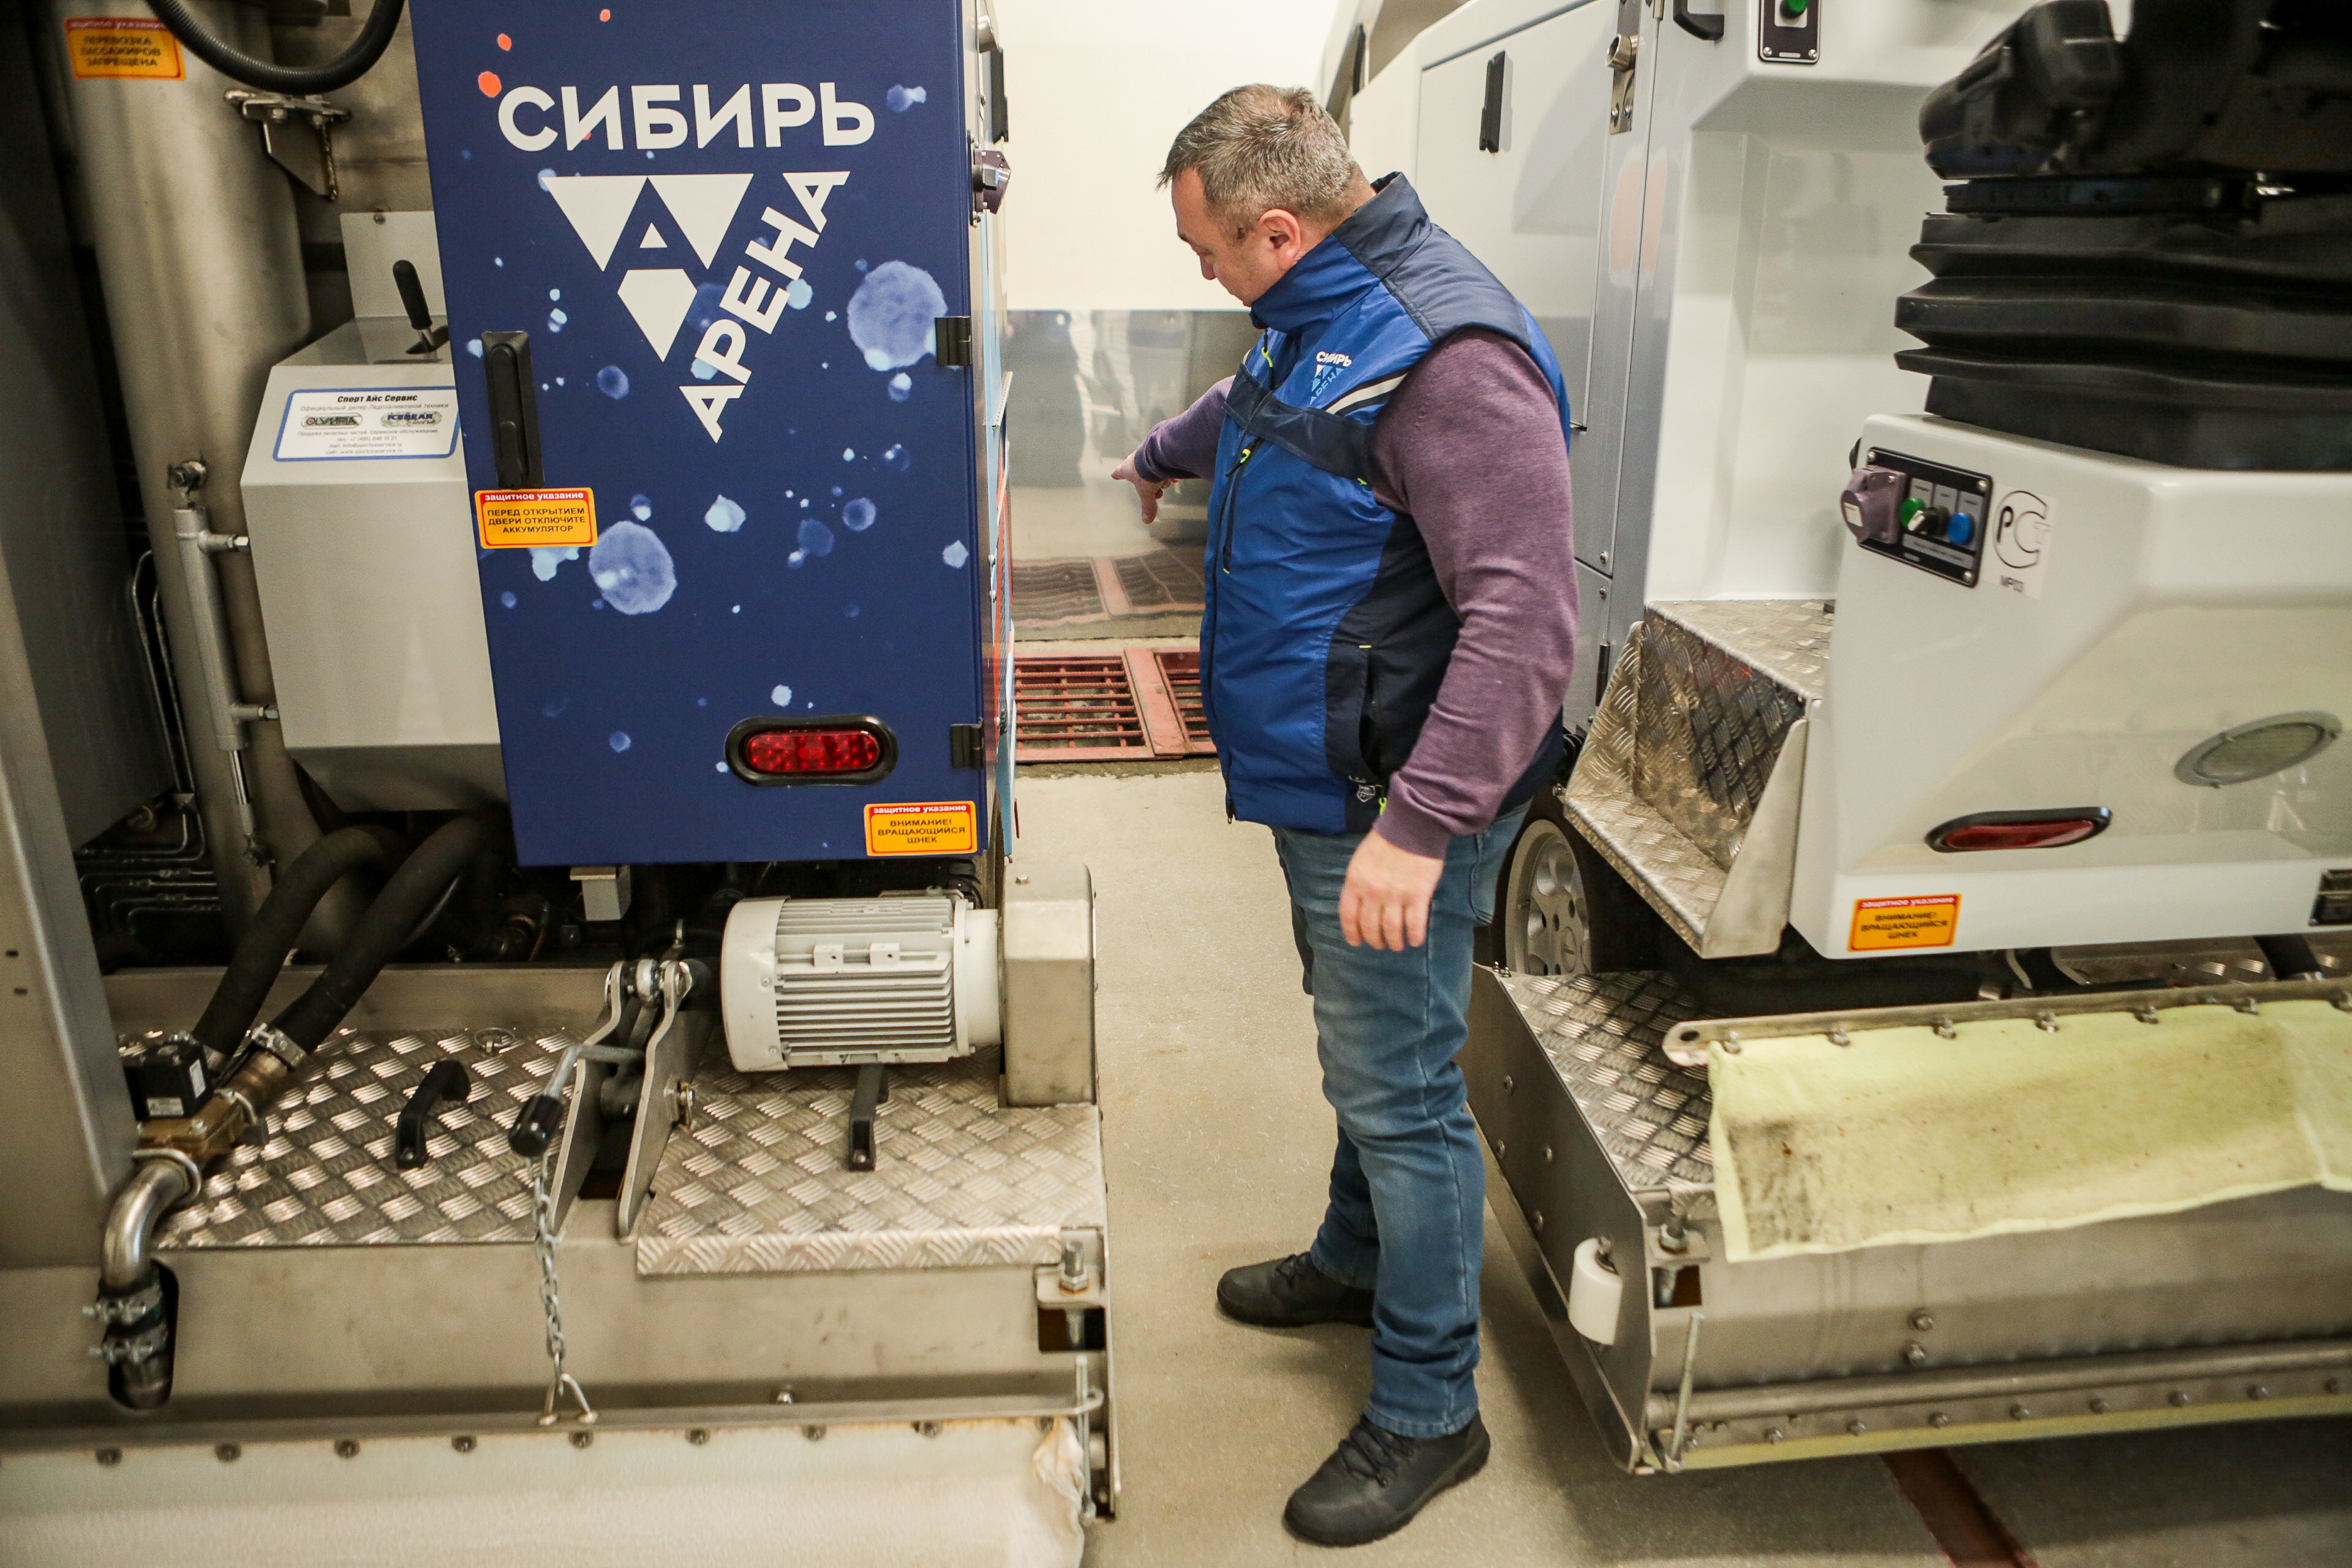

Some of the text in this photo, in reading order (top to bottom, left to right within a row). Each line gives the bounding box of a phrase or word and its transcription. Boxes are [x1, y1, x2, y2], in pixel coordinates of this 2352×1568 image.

[84, 36, 152, 45] ПЕРЕВОЗКА
[80, 47, 162, 56] ПАССАЖИРОВ
[85, 58, 158, 67] ЗАПРЕЩЕНА
[497, 81, 875, 152] СИБИРЬ
[679, 170, 851, 444] АРЕНА
[484, 492, 584, 502] защитное указание
[523, 507, 585, 516] ОТКРЫТИЕМ
[488, 516, 586, 526] ДВЕРИ ОТКЛЮЧИТЕ
[502, 525, 573, 533] АККУМУЛЯТОР
[922, 805, 967, 813] указание
[890, 818, 952, 827] ВНИМАНИЕ!
[878, 827, 965, 836] ВРАЩАЮЩИЙСЯ
[1861, 897, 1956, 908] защитное указание
[1875, 911, 1937, 921] ВНИМАНИЕ!
[1861, 921, 1948, 931] ВРАЩАЮЩИЙСЯ
